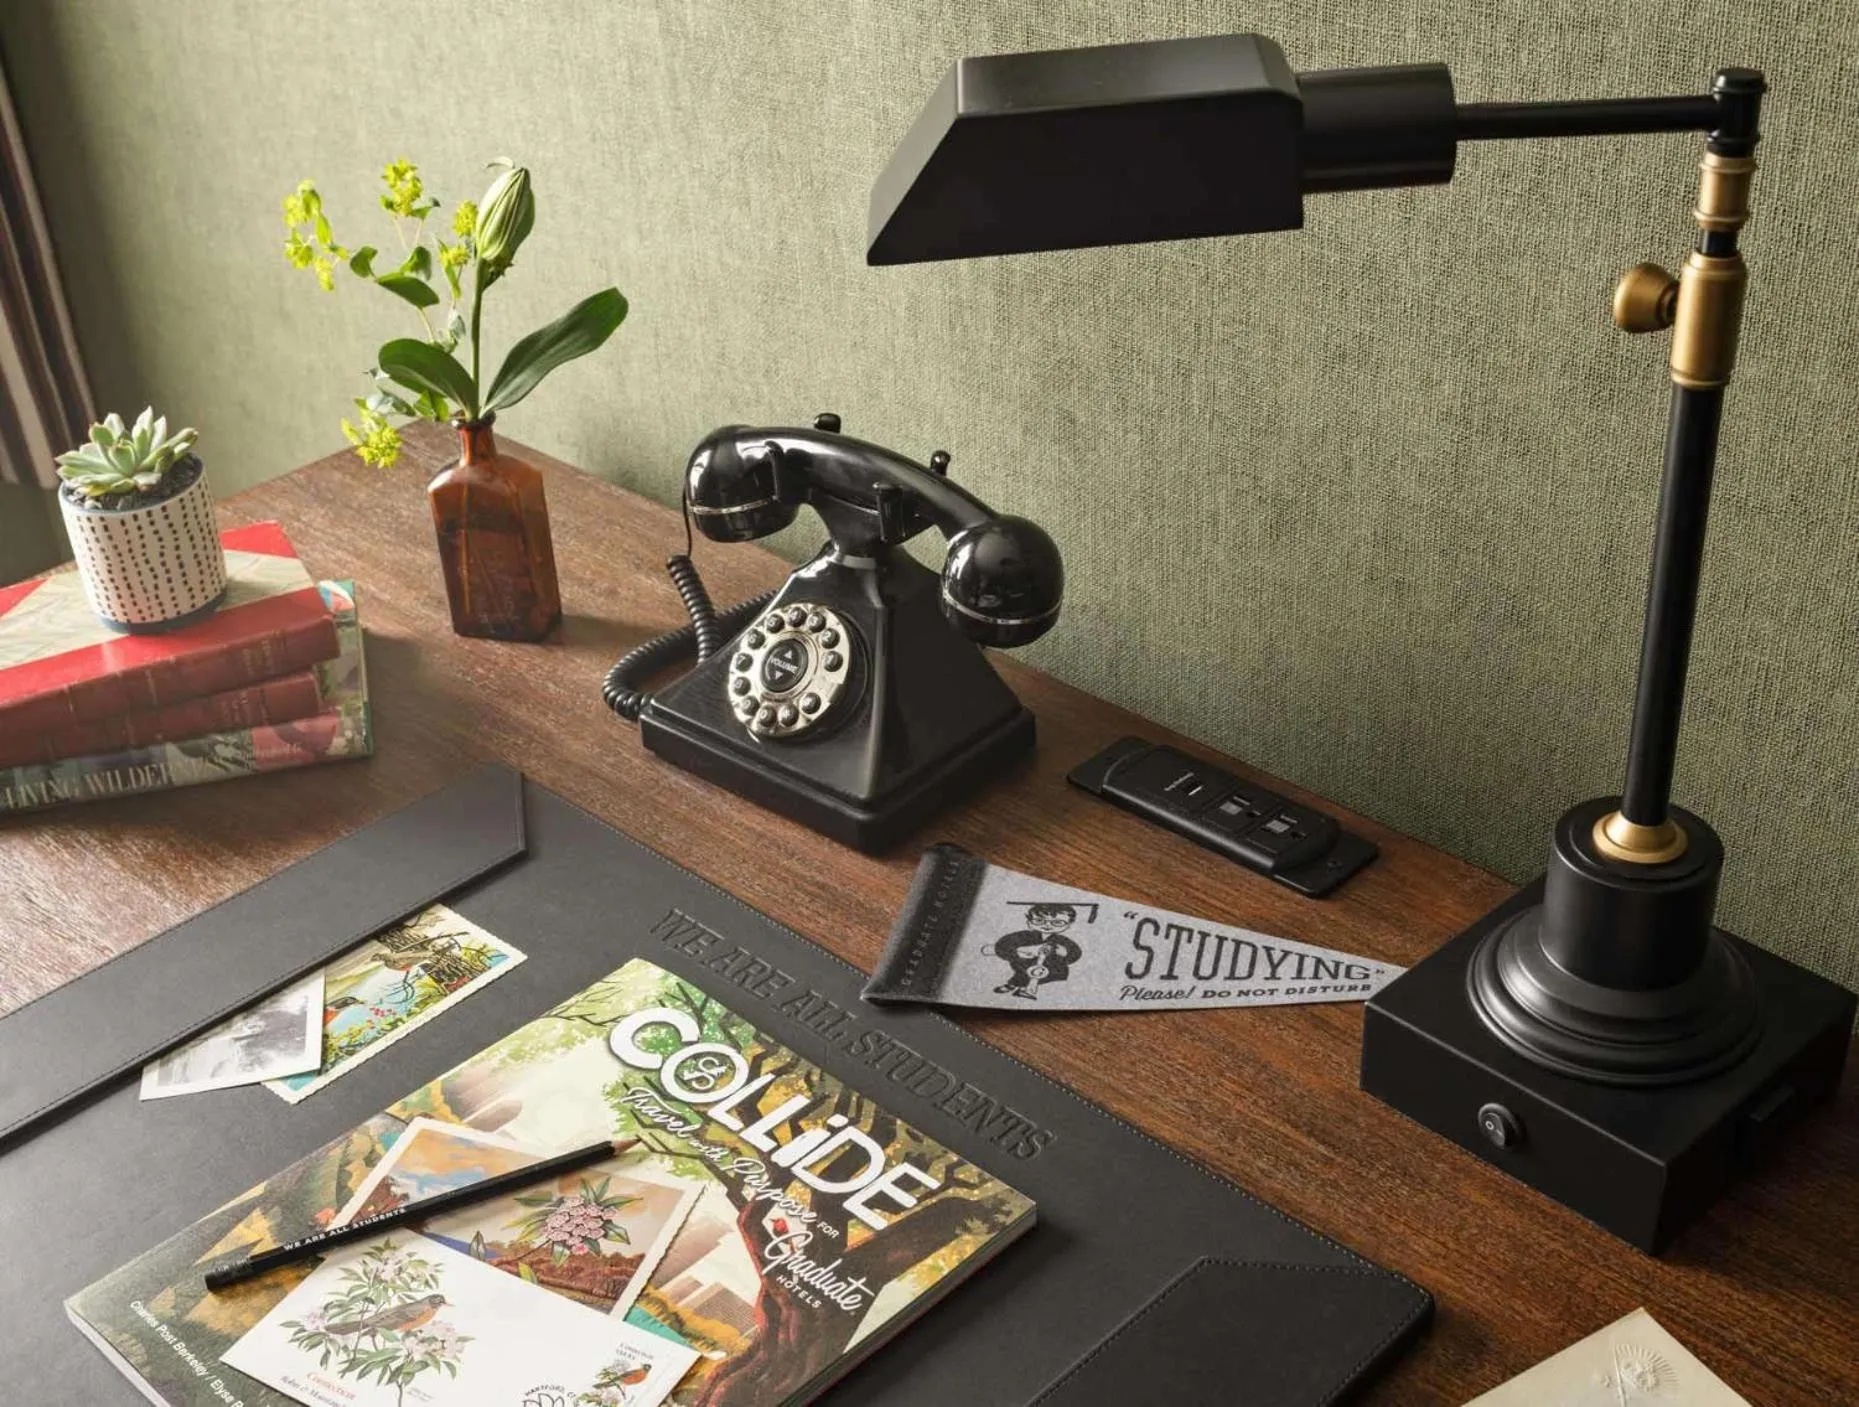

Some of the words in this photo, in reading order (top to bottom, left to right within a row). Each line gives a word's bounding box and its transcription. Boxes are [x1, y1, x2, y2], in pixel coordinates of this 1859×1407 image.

[1119, 984, 1197, 1001] Please!
[1201, 989, 1231, 999] DO
[1236, 988, 1279, 998] NOT
[1284, 983, 1373, 996] DISTURB
[650, 907, 725, 957] WE
[701, 945, 797, 1001] ARE
[772, 988, 858, 1041] ALL
[848, 1028, 1058, 1160] STUDENTS
[620, 1086, 701, 1139] Travel
[689, 1139, 730, 1162] with
[720, 1157, 817, 1223] Purpose
[816, 1220, 840, 1239] FOR
[283, 1241, 301, 1250] WE
[305, 1233, 326, 1245] ARE
[329, 1225, 351, 1237] ALL
[352, 1207, 406, 1230] STUDENTS
[761, 1230, 875, 1311] Graduate
[776, 1274, 822, 1309] HOTELS
[155, 1323, 178, 1345] Post
[172, 1341, 209, 1377] Berkeley
